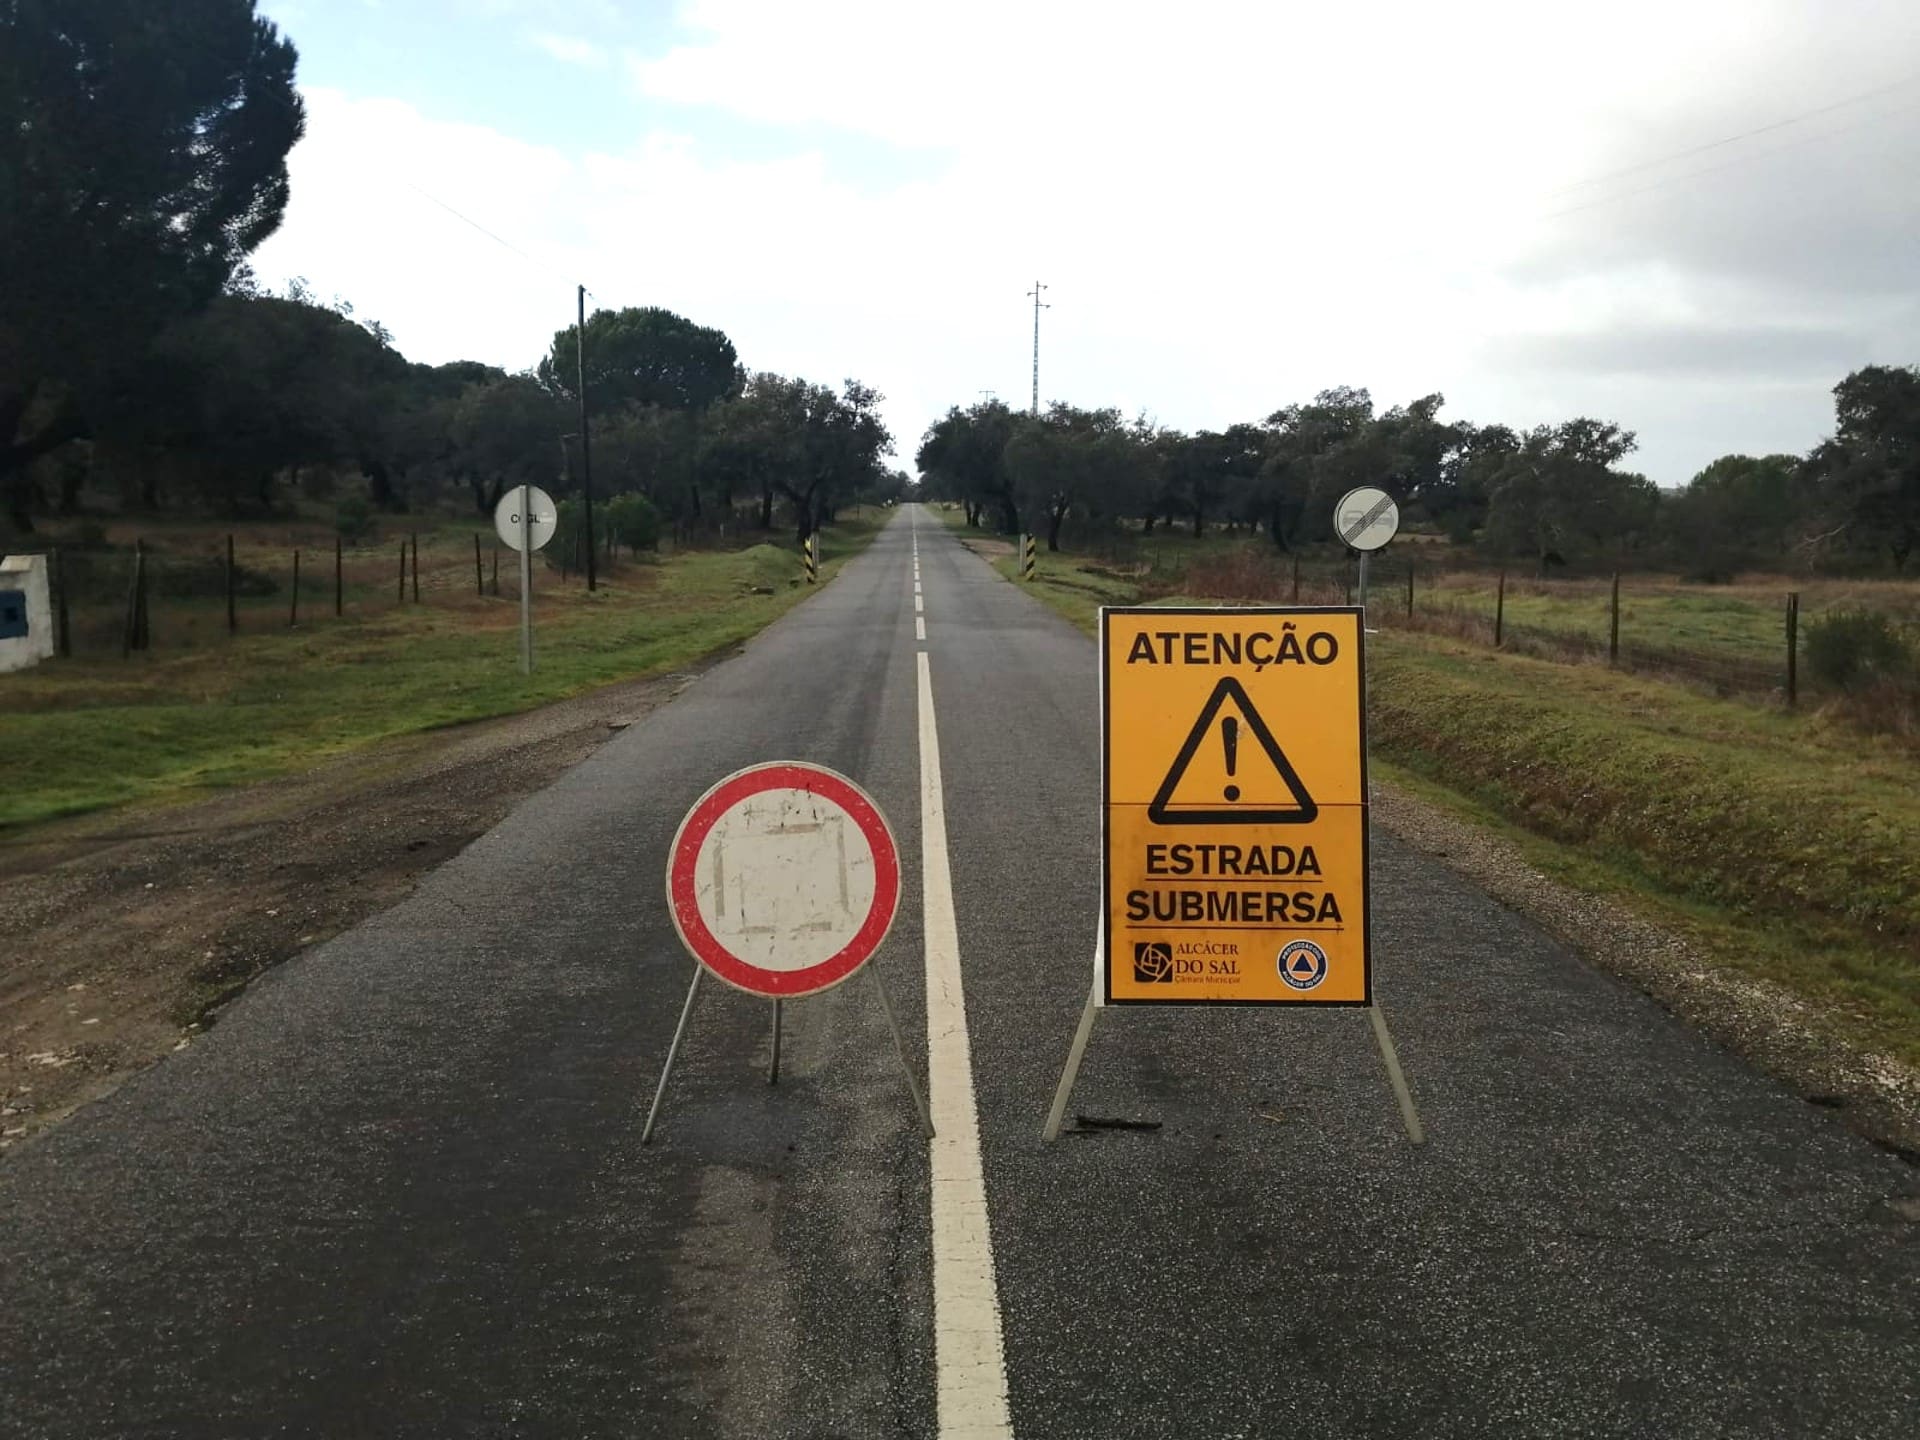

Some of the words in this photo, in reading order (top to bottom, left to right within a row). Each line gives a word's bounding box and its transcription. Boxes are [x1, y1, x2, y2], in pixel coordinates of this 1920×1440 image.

[1127, 622, 1339, 672] ATENÇÃO
[1146, 844, 1322, 875] ESTRADA
[1126, 890, 1343, 923] SUBMERSA
[1176, 941, 1239, 955] ALCÁCER
[1175, 959, 1204, 974] DO
[1209, 959, 1241, 975] SAL
